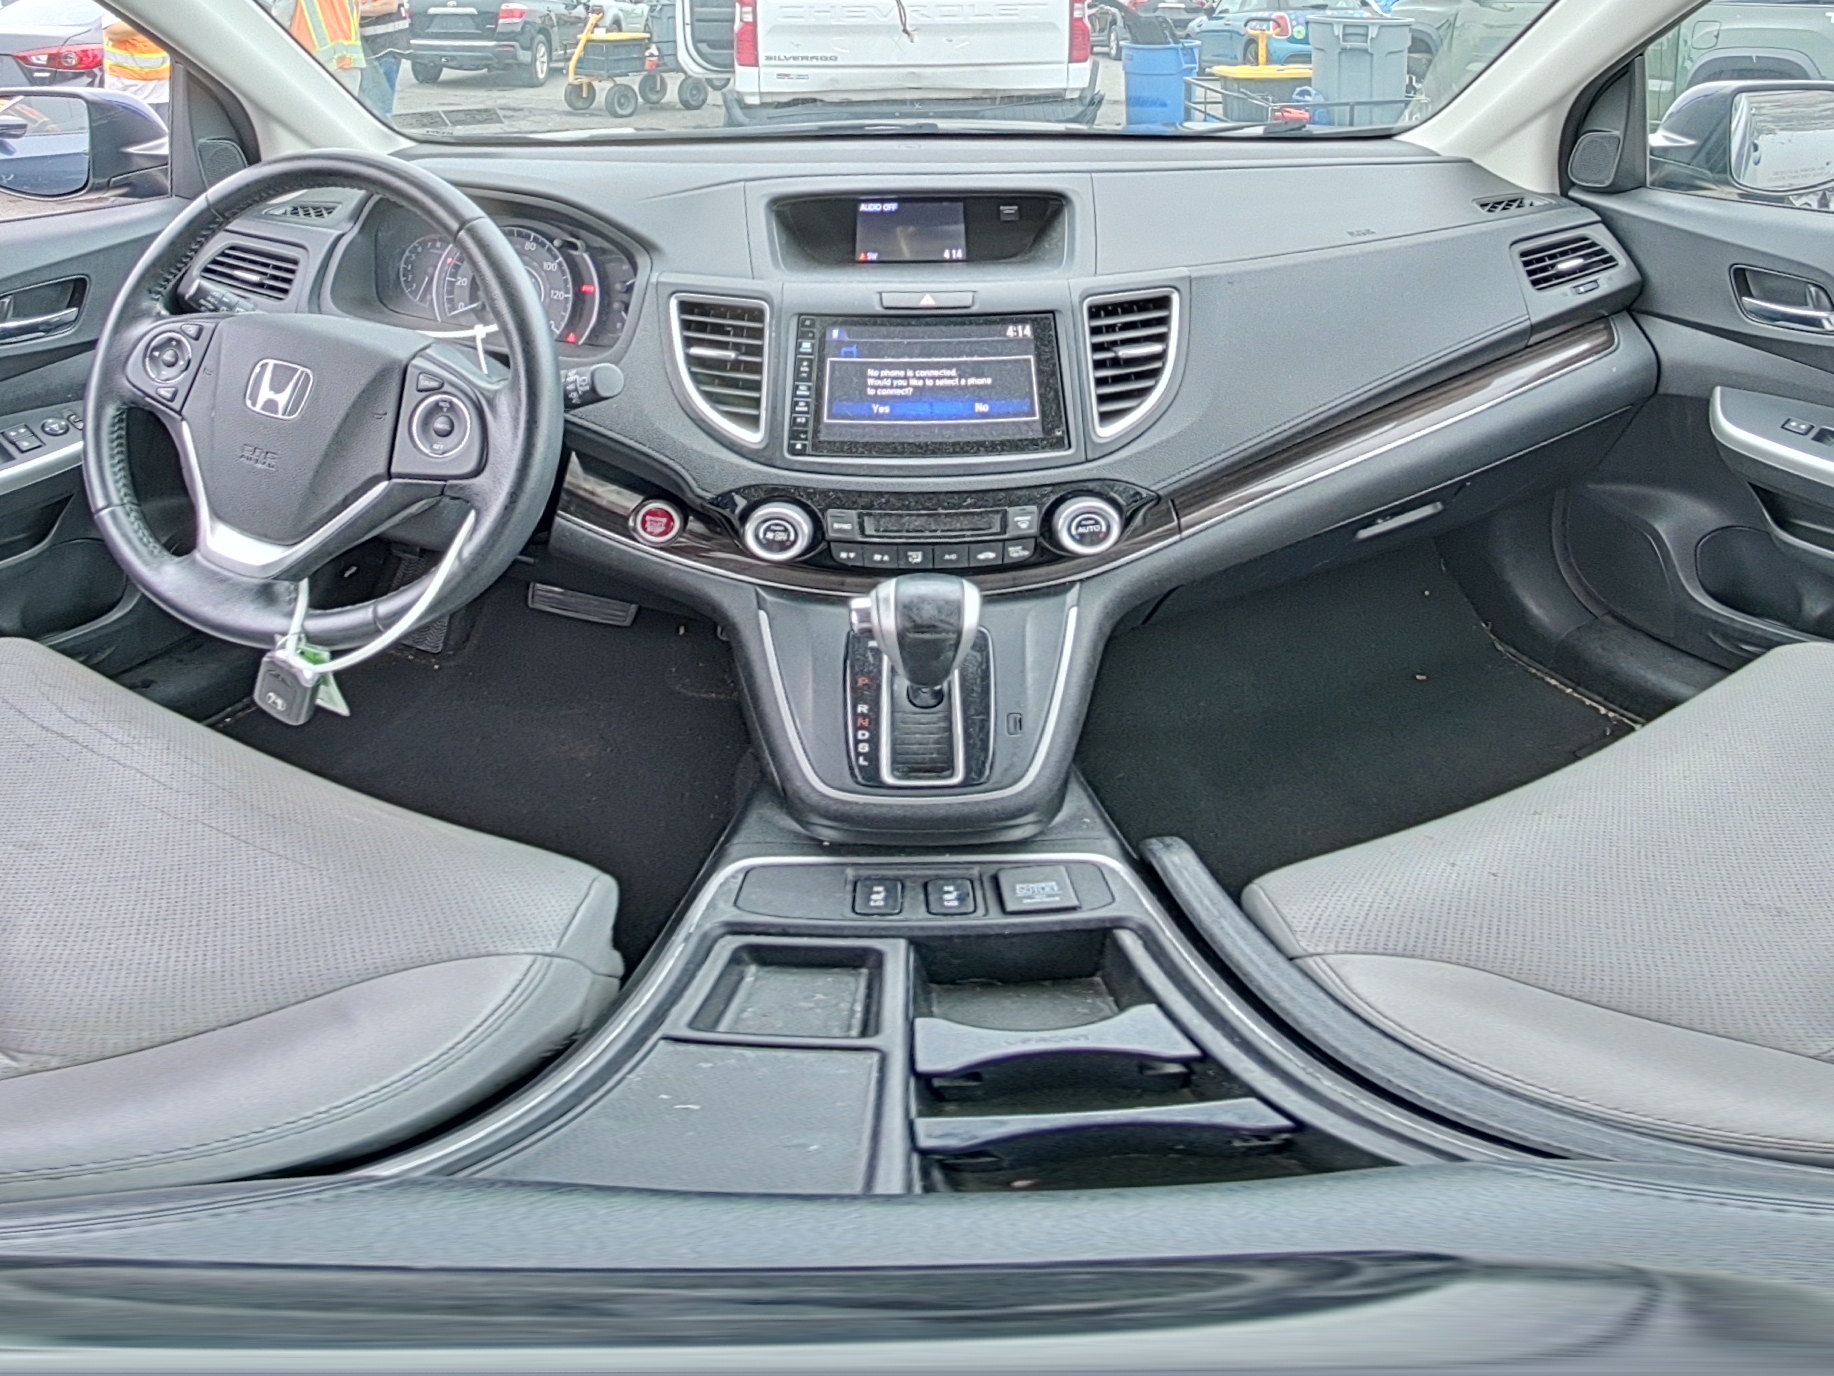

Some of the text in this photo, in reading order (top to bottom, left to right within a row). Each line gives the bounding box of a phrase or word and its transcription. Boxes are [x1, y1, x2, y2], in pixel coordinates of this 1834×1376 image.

[777, 3, 1049, 22] CHEVROLET
[859, 202, 898, 212] AUDIO OFF
[524, 241, 536, 251] 80
[542, 262, 558, 272] 100
[455, 277, 468, 287] 20
[550, 290, 565, 299] 120
[1006, 325, 1032, 338] 4:14
[867, 368, 958, 378] No phone is connected.
[867, 378, 891, 386] Would
[892, 378, 907, 387] you
[909, 377, 923, 386] like
[925, 378, 934, 386] to
[935, 377, 959, 386] select
[967, 377, 992, 387] phone
[867, 387, 913, 396] to connect?
[872, 403, 890, 414] Yes
[975, 403, 989, 412] No
[833, 522, 852, 530] SYNC
[1077, 525, 1100, 533] AUTO
[857, 704, 869, 714] R
[857, 717, 870, 728] N
[857, 730, 869, 740] D
[858, 757, 869, 766] L
